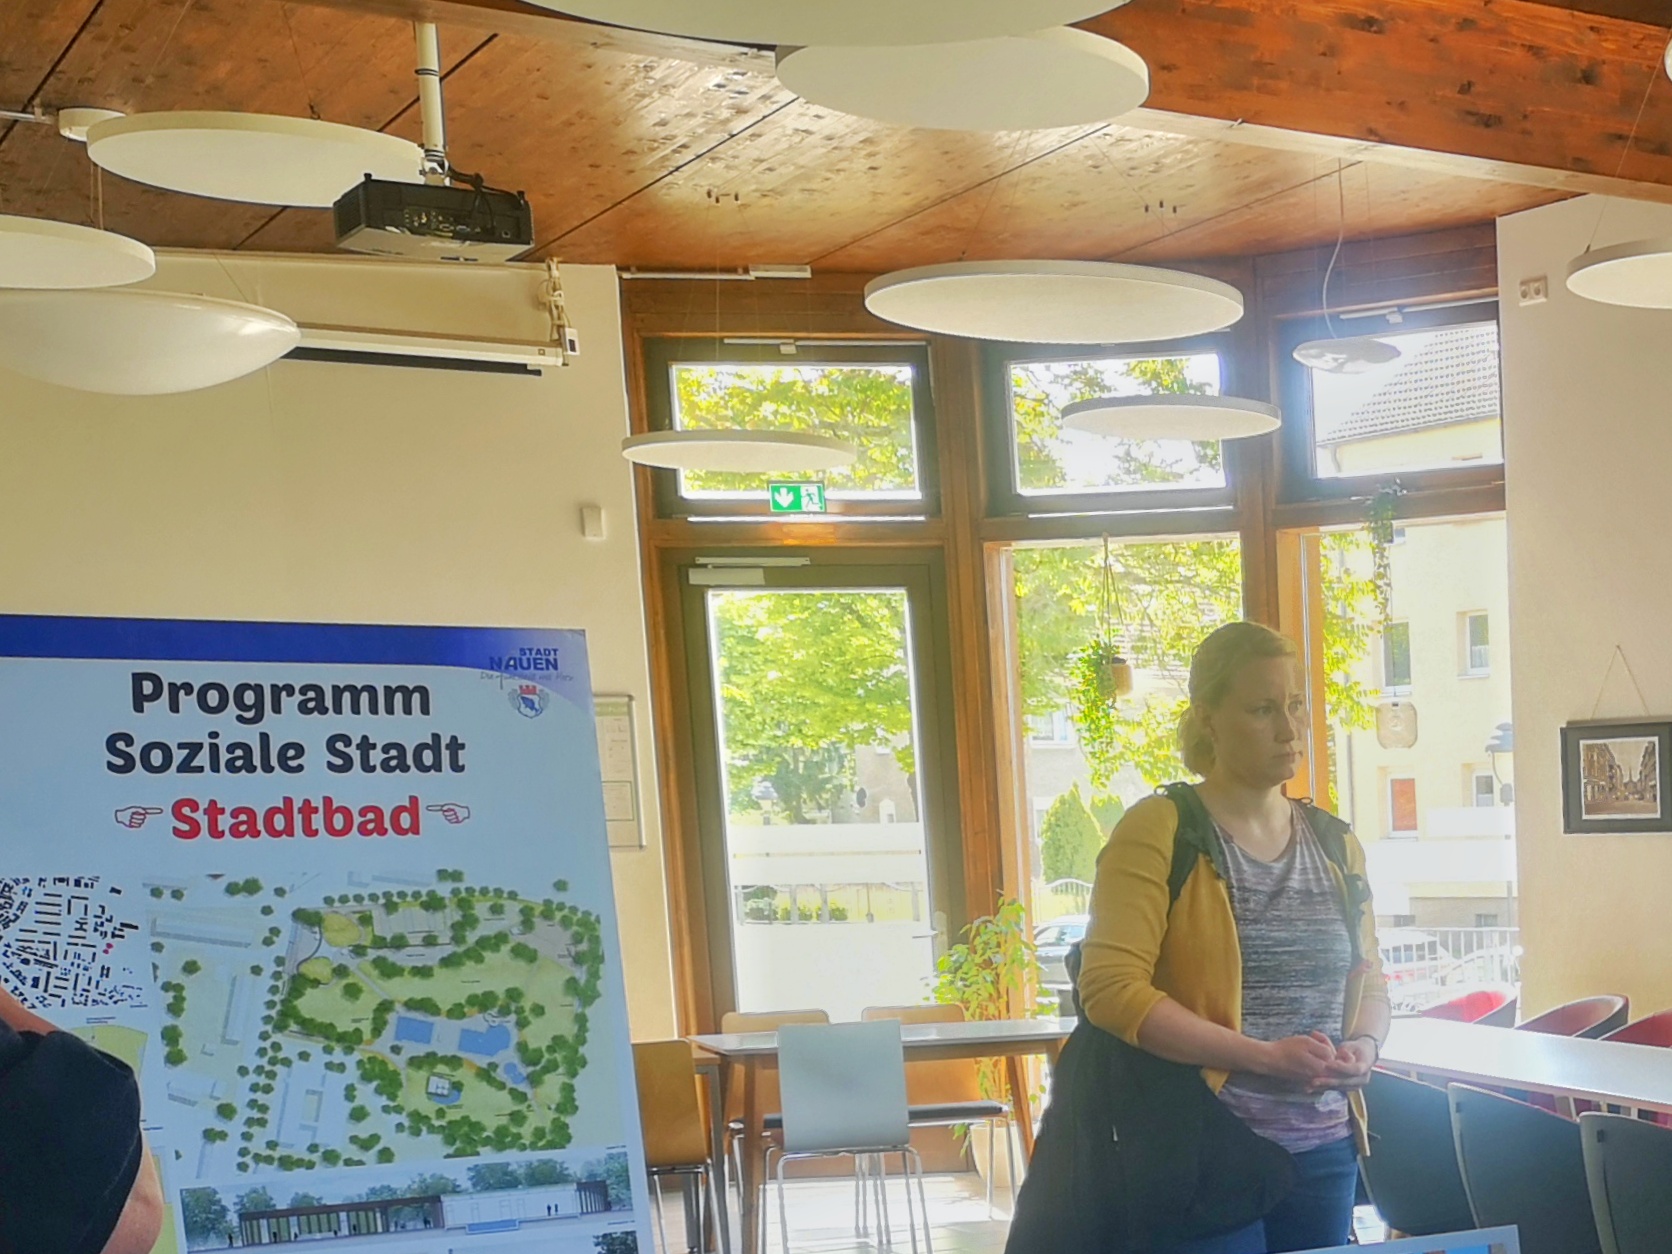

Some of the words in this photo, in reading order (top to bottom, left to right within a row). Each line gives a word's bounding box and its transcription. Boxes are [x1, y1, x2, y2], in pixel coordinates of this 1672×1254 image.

[489, 656, 559, 671] NAUEN
[519, 647, 559, 657] STADT
[131, 671, 431, 725] Programm
[105, 731, 306, 774] Soziale
[325, 732, 466, 774] Stadt
[171, 796, 421, 840] Stadtbad
